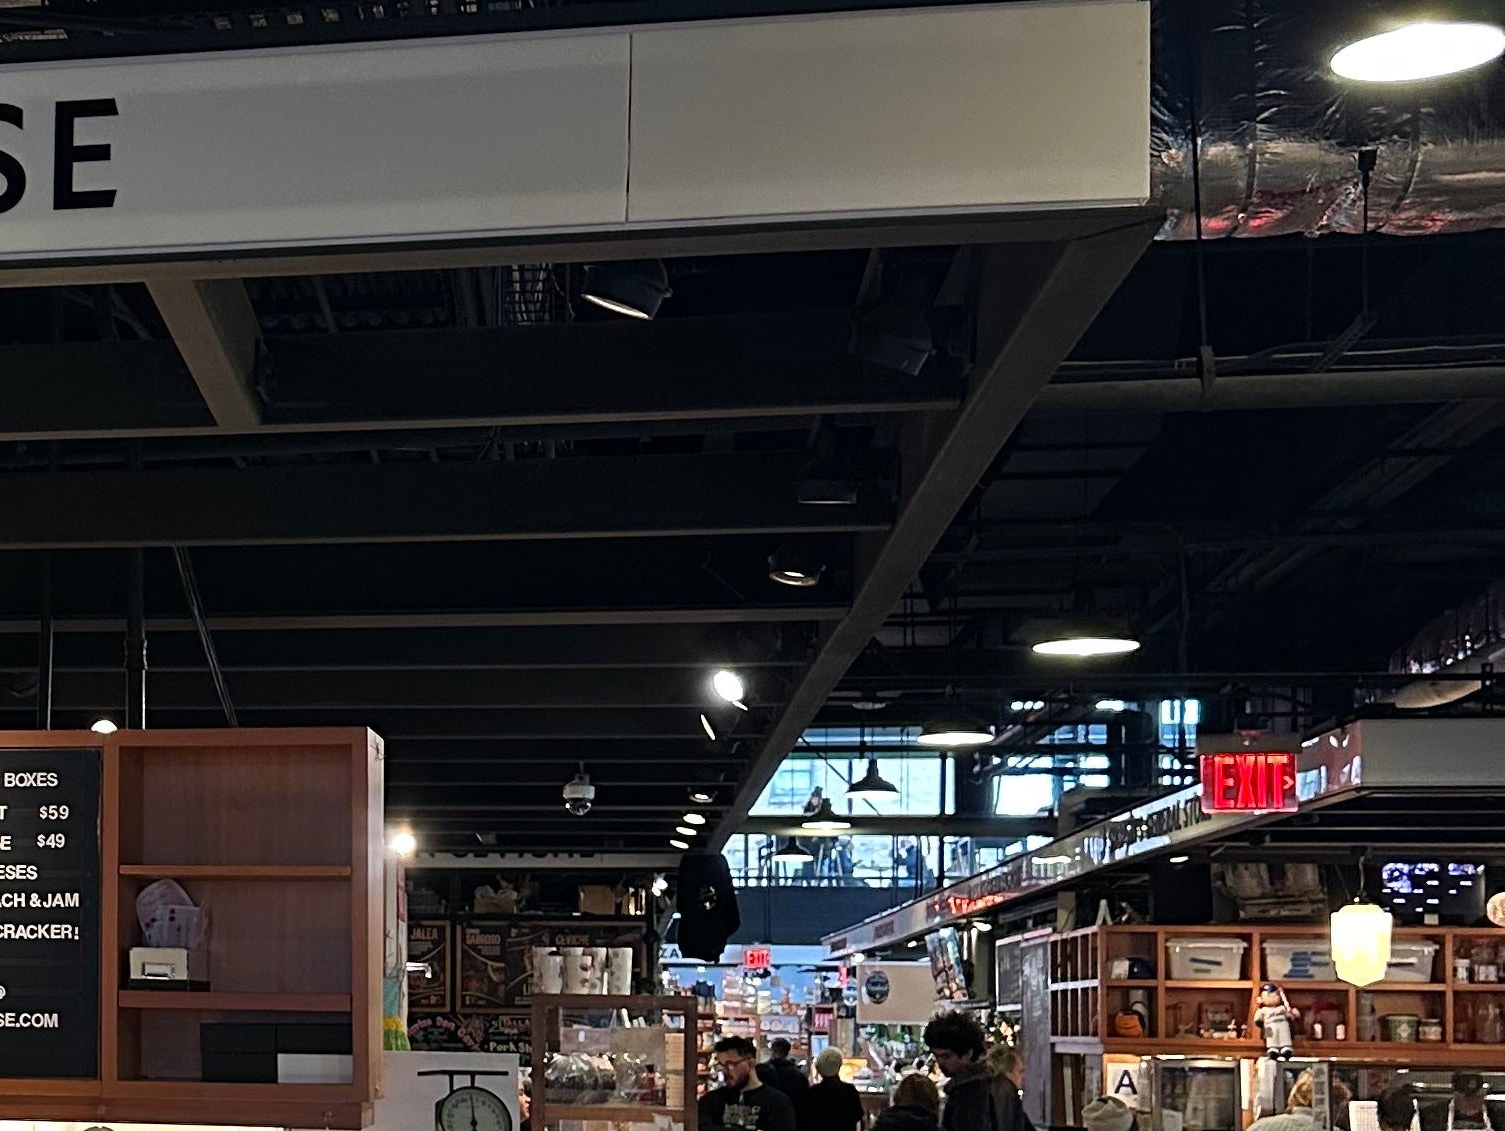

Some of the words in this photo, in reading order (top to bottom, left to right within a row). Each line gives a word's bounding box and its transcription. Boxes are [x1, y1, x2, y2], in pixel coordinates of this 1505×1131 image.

[3, 772, 59, 788] BOXES
[1213, 754, 1289, 809] EXIT
[39, 804, 70, 821] $59
[37, 833, 66, 849] $49
[1113, 1069, 1138, 1095] A
